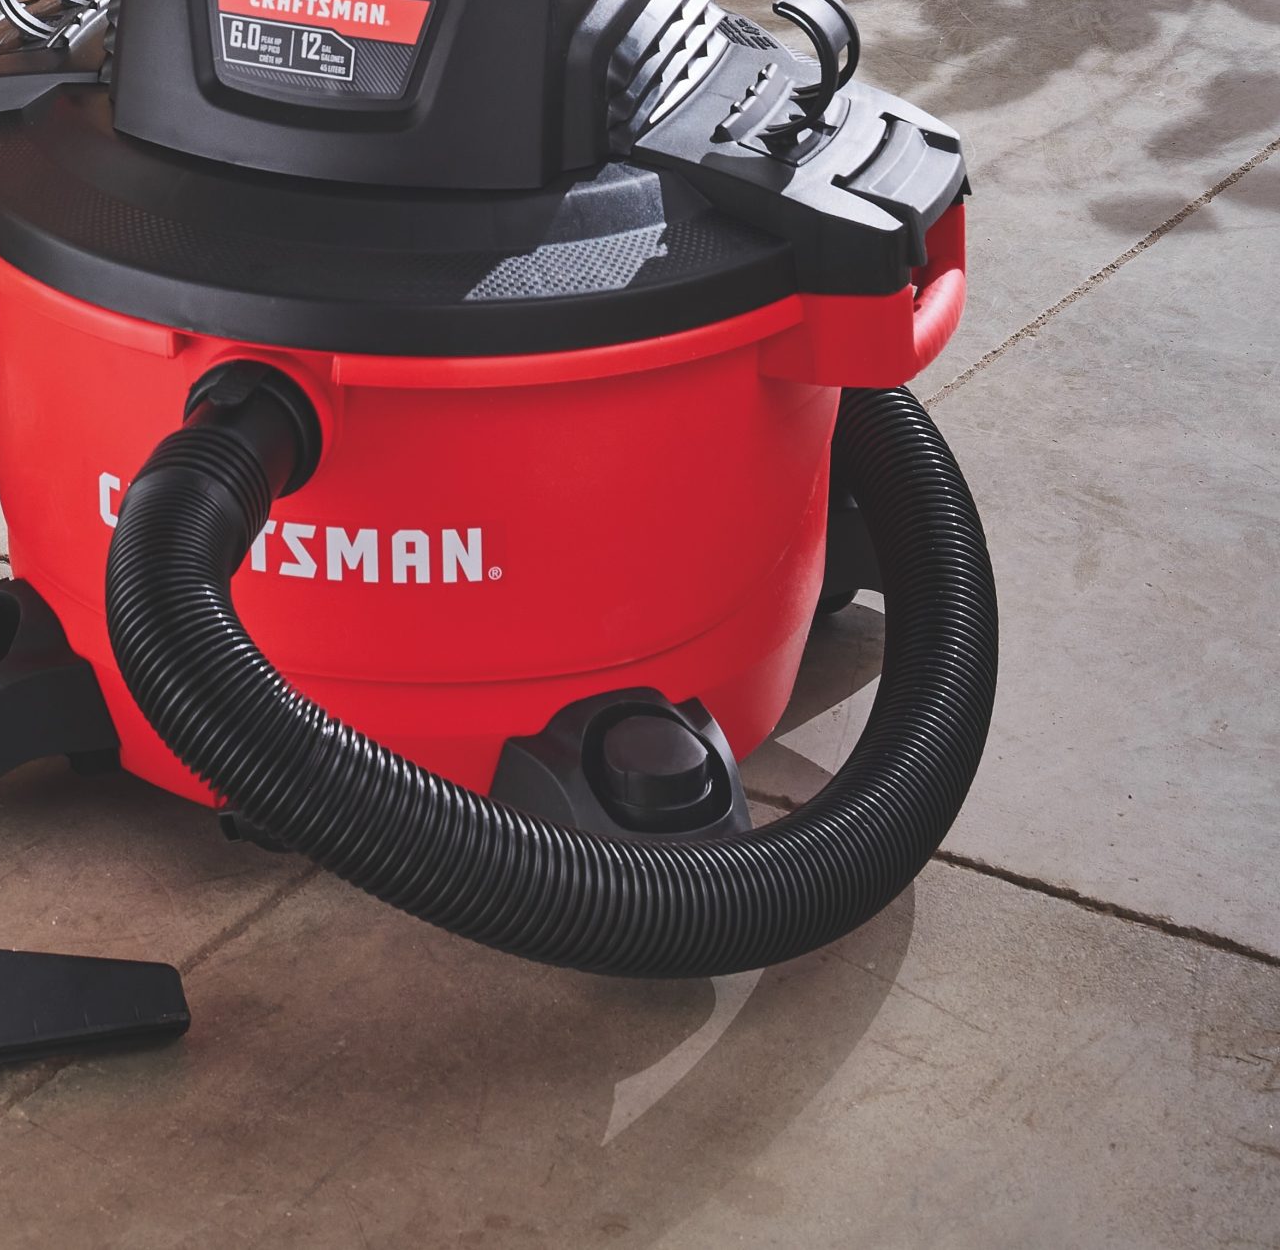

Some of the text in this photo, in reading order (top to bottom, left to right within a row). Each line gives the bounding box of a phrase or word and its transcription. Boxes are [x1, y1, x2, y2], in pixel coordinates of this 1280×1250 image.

[230, 20, 261, 50] 6.0
[261, 36, 274, 44] PEAK
[301, 32, 321, 60] 12
[322, 45, 332, 53] GAL
[320, 53, 345, 64] GALONES
